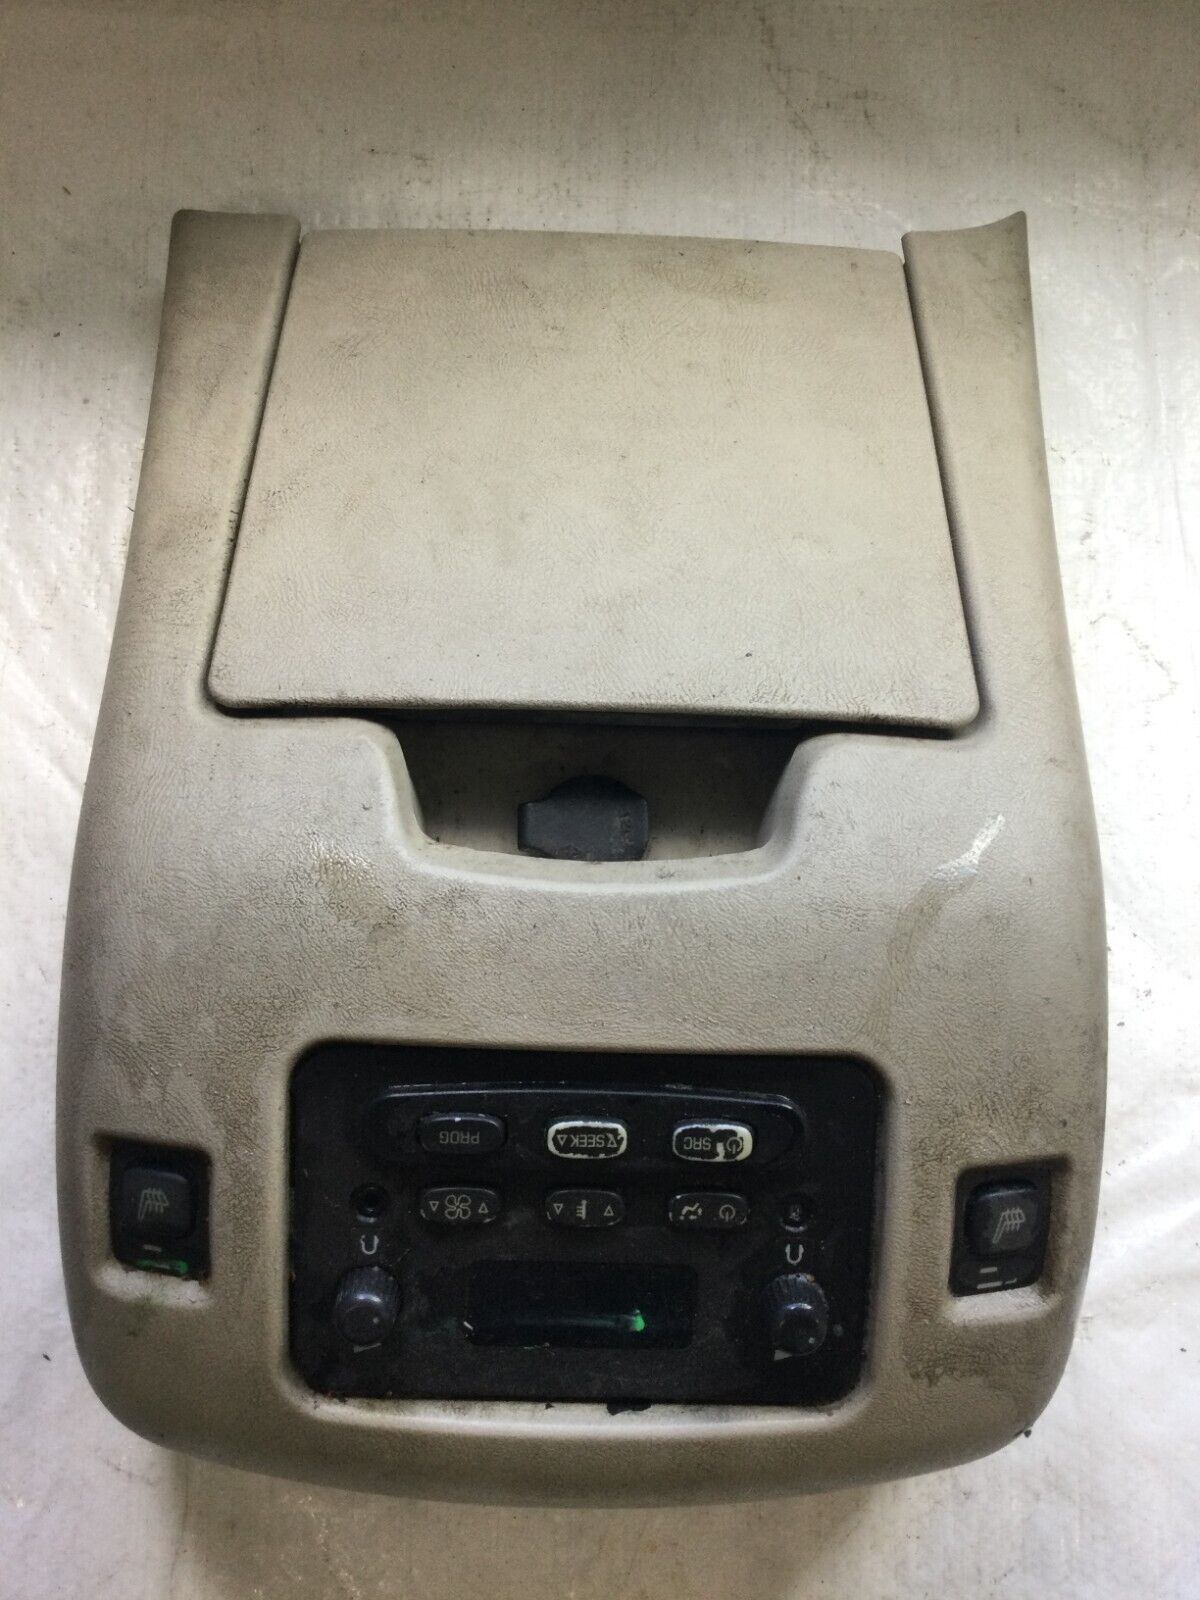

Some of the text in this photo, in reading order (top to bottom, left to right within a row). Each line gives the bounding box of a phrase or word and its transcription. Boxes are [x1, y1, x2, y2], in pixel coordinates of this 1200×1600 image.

[439, 1130, 481, 1145] PROG
[570, 1134, 606, 1148] SEEK
[683, 1136, 712, 1151] SRC
